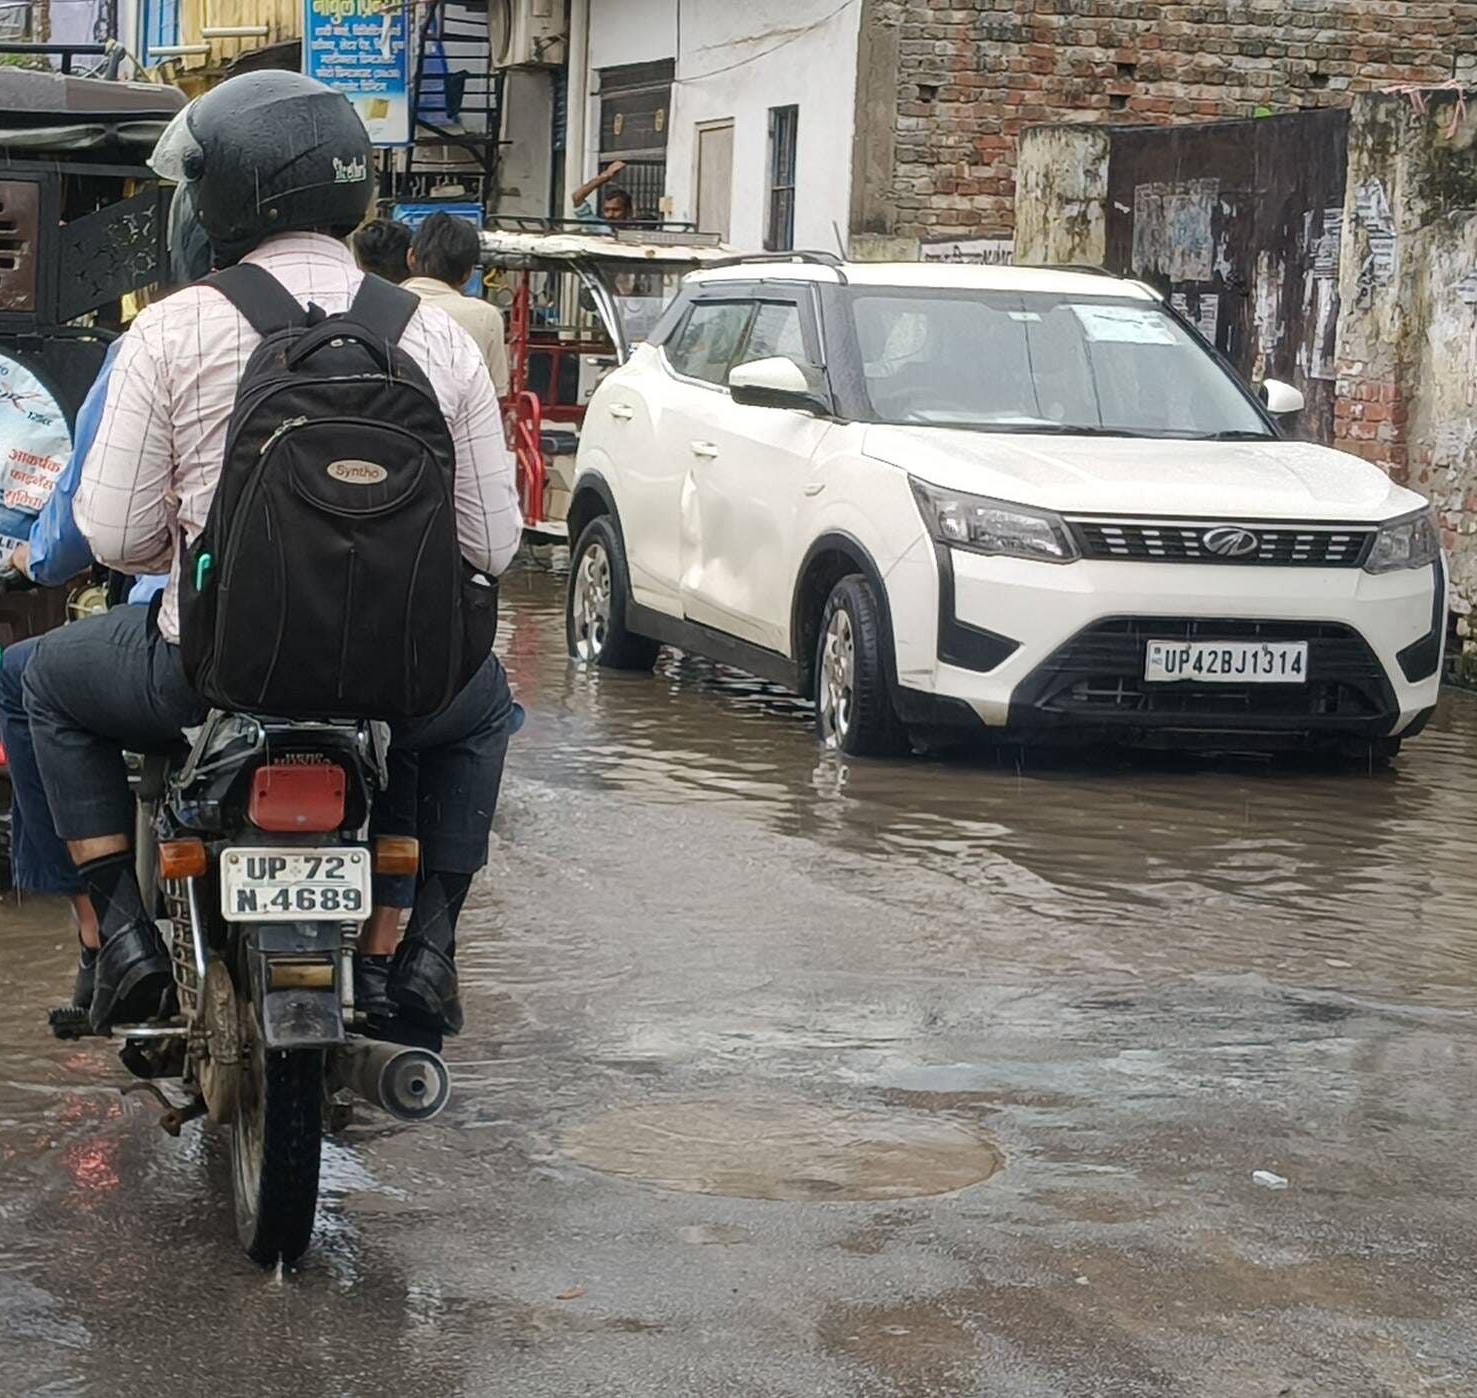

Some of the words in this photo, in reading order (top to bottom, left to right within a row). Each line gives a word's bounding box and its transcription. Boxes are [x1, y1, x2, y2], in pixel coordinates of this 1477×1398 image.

[336, 464, 380, 479] Syntho
[1165, 650, 1302, 674] UP42BJ1314
[247, 857, 287, 880] UP
[303, 857, 345, 880] 72
